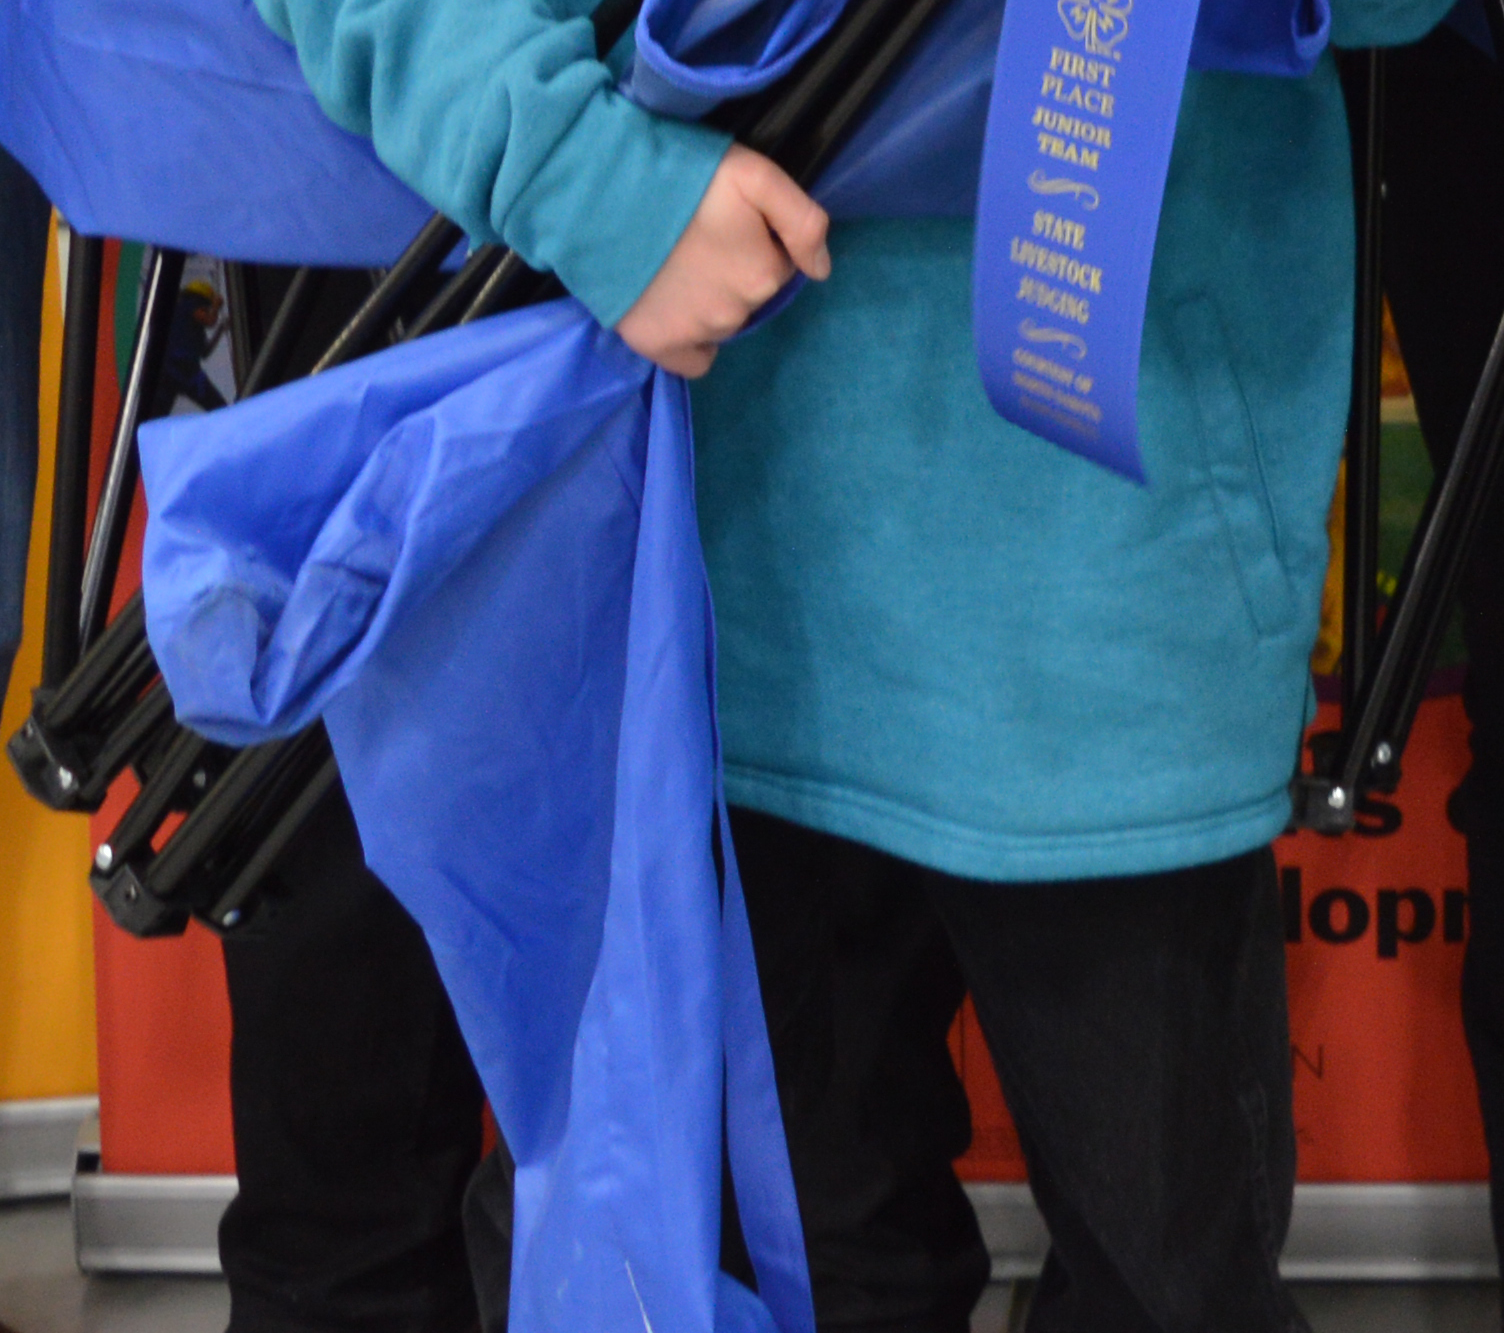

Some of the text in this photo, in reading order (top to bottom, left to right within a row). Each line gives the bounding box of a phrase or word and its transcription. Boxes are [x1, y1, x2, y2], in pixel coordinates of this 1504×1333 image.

[1050, 46, 1116, 88] FIRST
[1041, 71, 1114, 119] PLACE
[1032, 105, 1112, 150] JUNIOR
[1037, 131, 1100, 171] TEAM
[1032, 209, 1086, 251] STATE
[1010, 235, 1103, 295] LIVESTOCK
